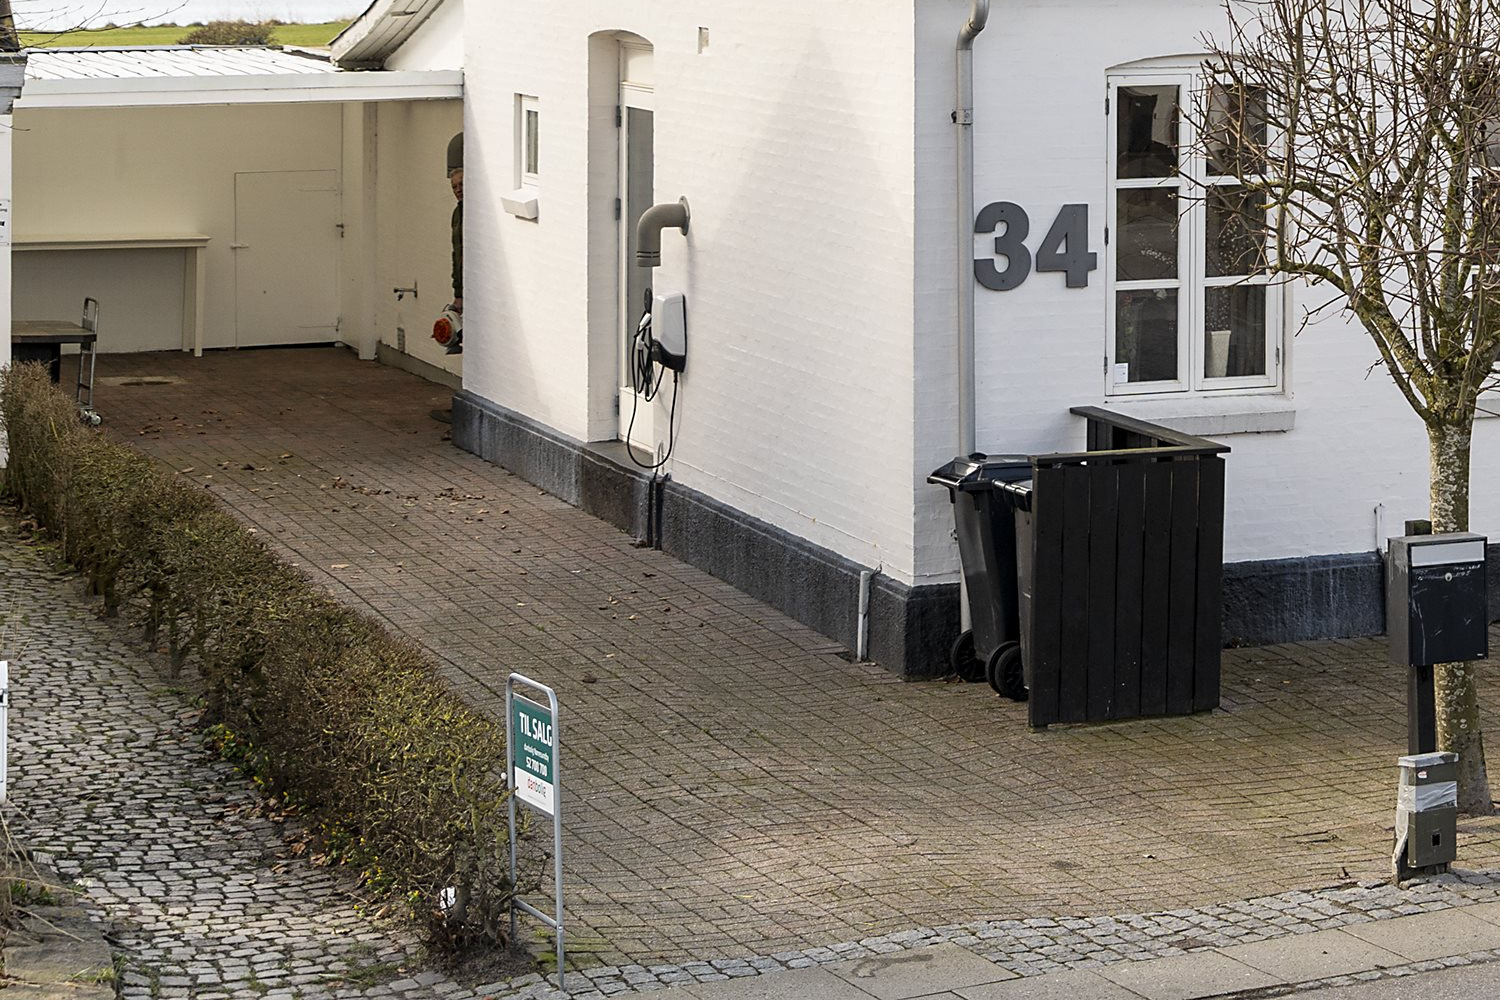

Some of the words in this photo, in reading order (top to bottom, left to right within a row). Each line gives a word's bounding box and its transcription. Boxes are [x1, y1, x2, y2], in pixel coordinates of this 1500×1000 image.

[974, 201, 1097, 291] 34
[519, 712, 531, 737] TIL
[532, 718, 553, 747] SALG
